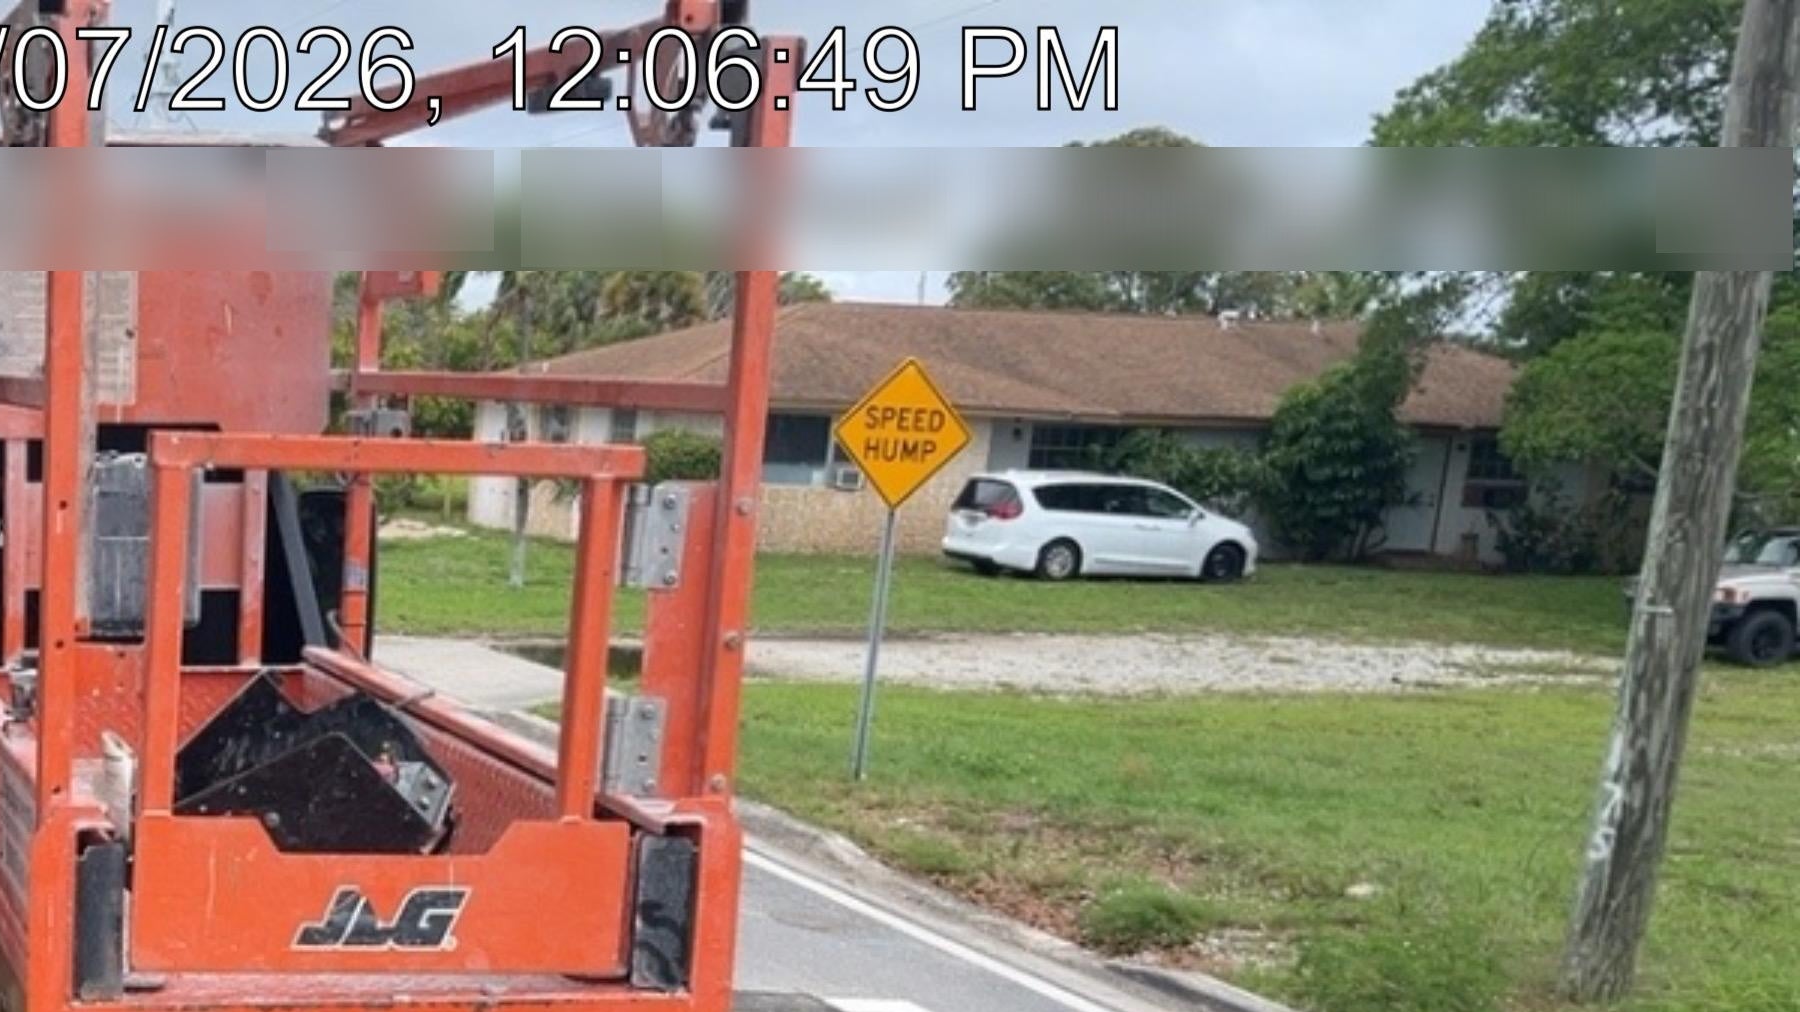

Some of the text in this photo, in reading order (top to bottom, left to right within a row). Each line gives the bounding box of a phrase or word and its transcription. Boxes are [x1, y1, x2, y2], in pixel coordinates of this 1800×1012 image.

[864, 404, 946, 432] SPEED
[864, 437, 937, 463] HUMP
[291, 884, 473, 951] JLG
